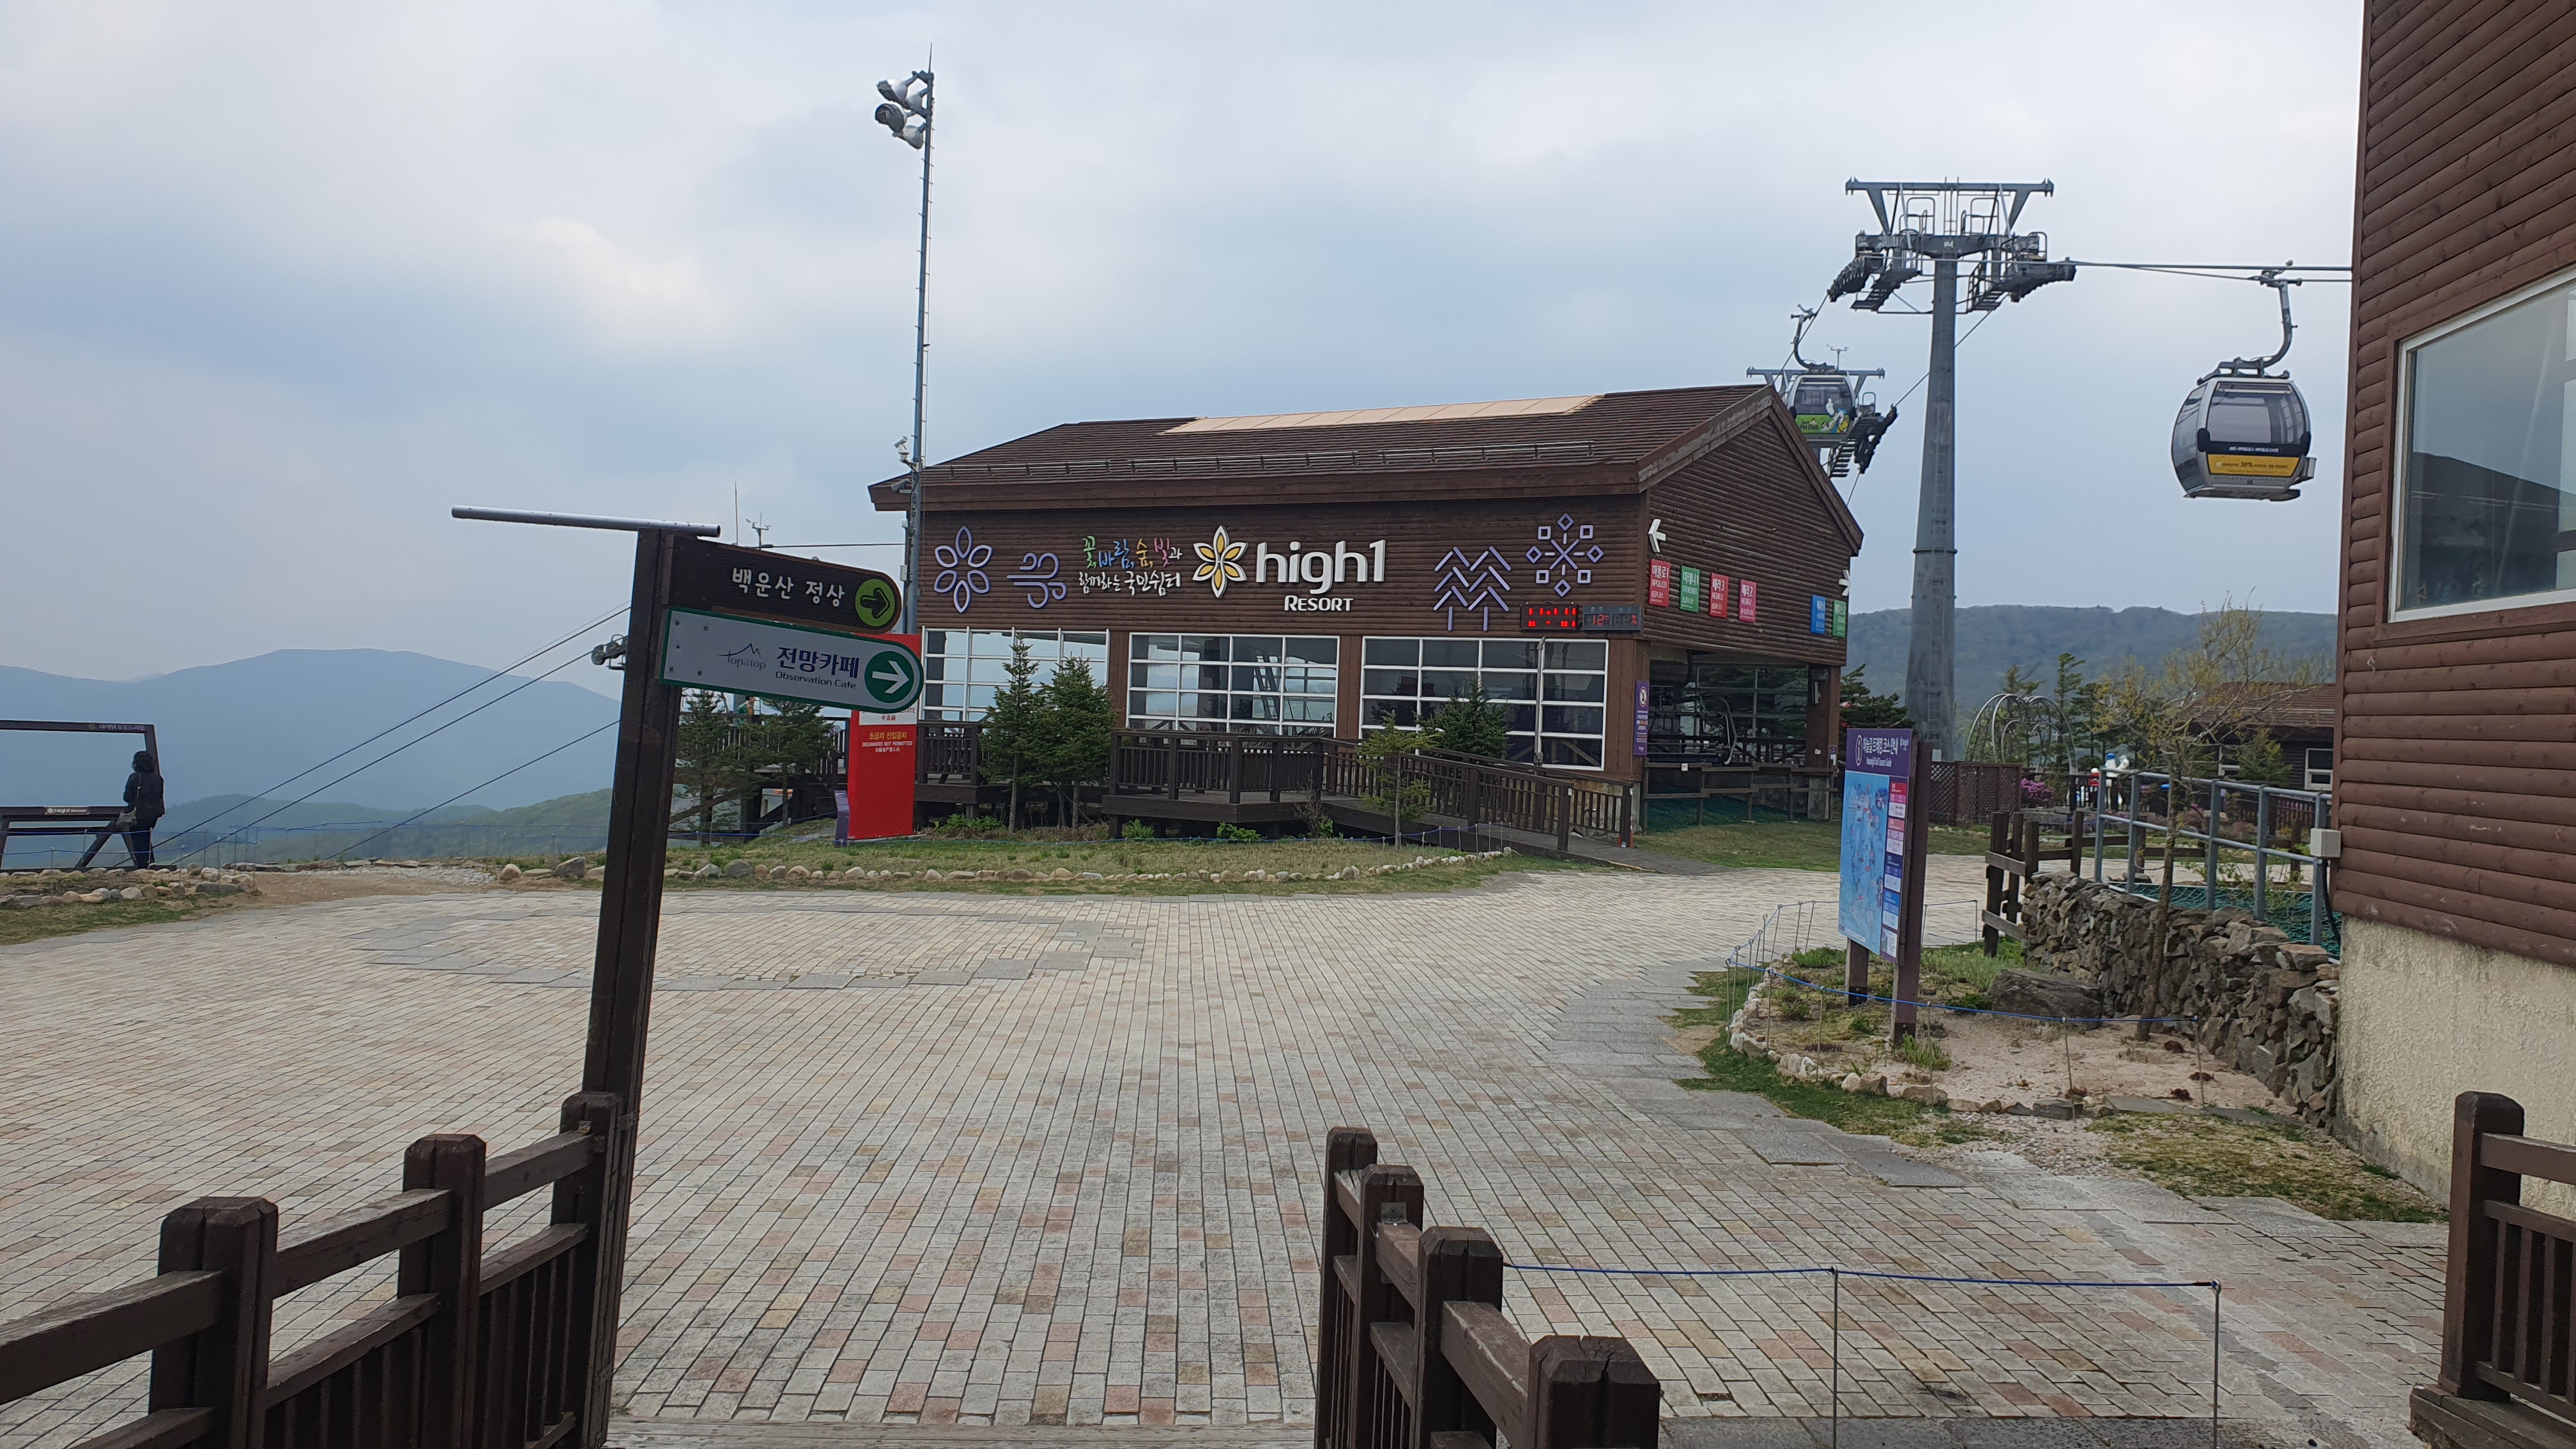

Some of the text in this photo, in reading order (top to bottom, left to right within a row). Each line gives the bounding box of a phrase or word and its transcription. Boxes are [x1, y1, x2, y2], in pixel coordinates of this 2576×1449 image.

[1256, 540, 1386, 594] high1
[732, 567, 845, 607] 백운산 정상
[1078, 570, 1181, 596] 함께하는 국민쉼터
[777, 647, 859, 678] 전망카페
[775, 671, 856, 689] Observation Cafe
[887, 732, 907, 740] 진입금지
